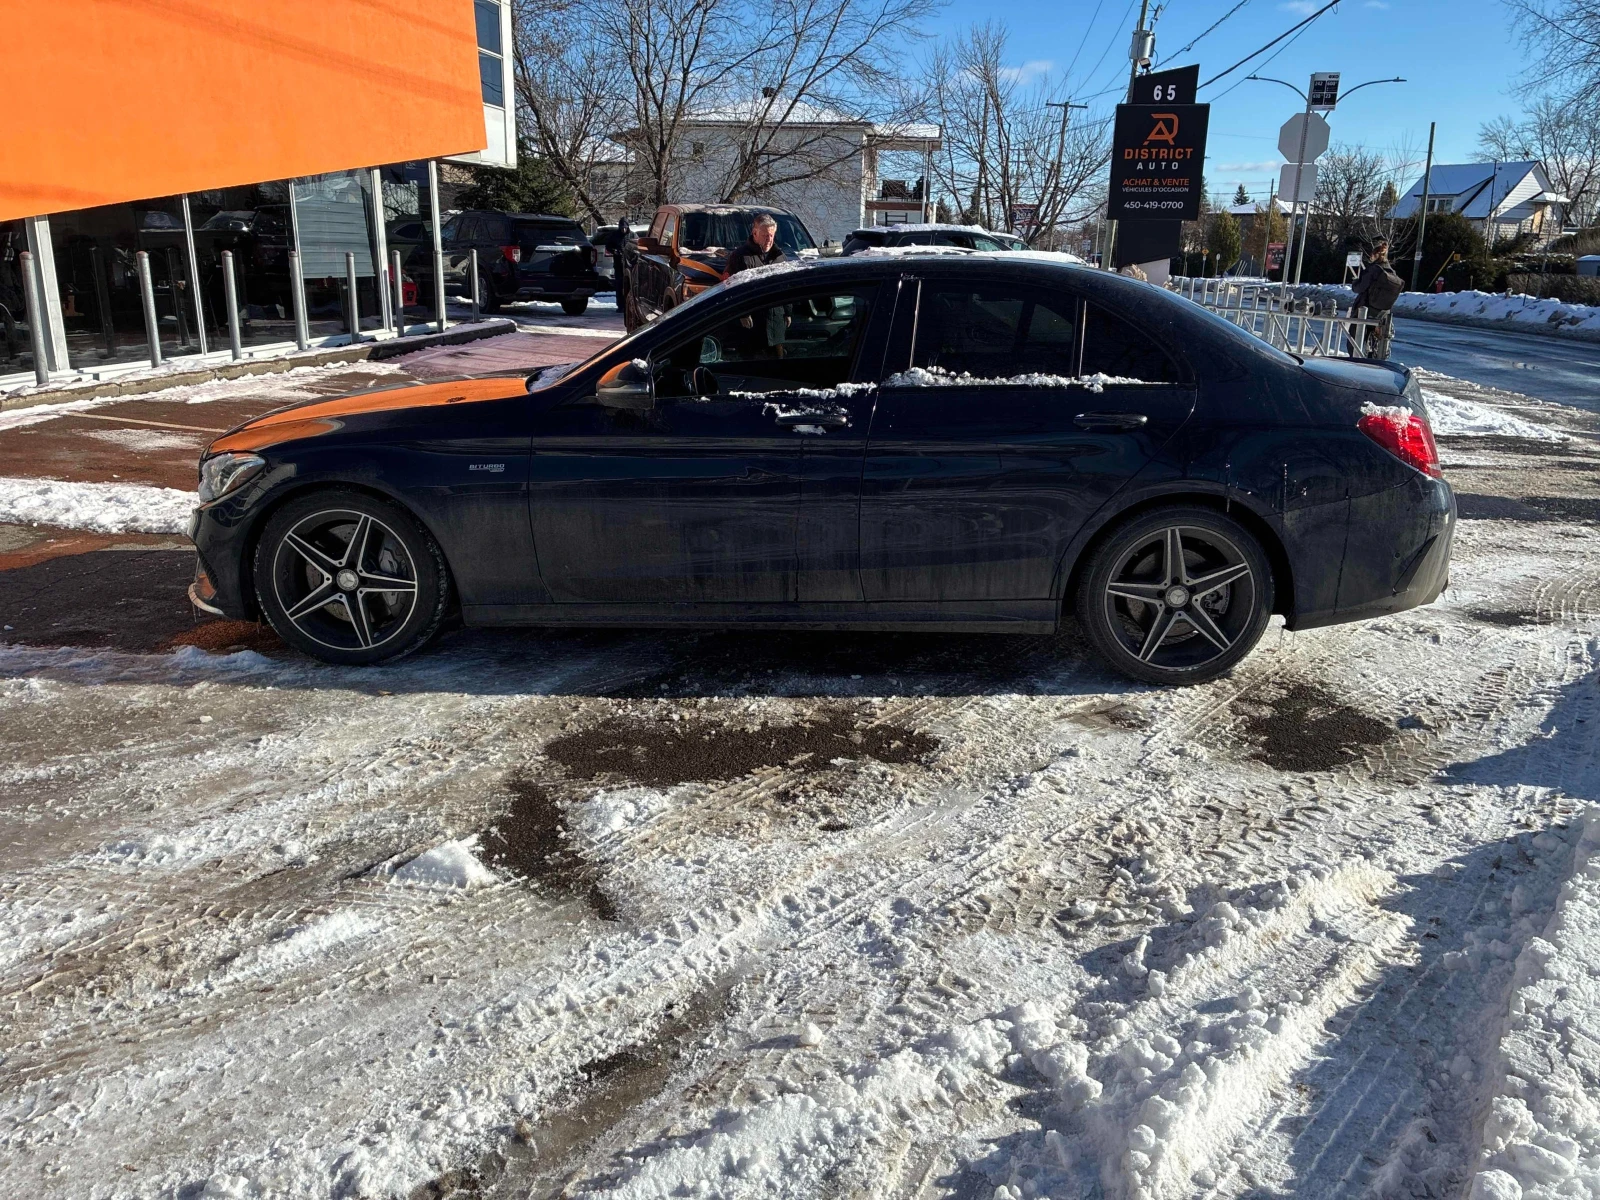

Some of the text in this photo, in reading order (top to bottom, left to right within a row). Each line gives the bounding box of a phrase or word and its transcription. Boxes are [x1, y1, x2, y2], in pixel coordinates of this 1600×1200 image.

[1153, 84, 1176, 101] 65
[1124, 148, 1193, 159] DISTRICT
[1136, 161, 1179, 170] AUTO
[1122, 178, 1190, 186] ACHAT & VENTE
[1124, 201, 1184, 209] 450-419-0700
